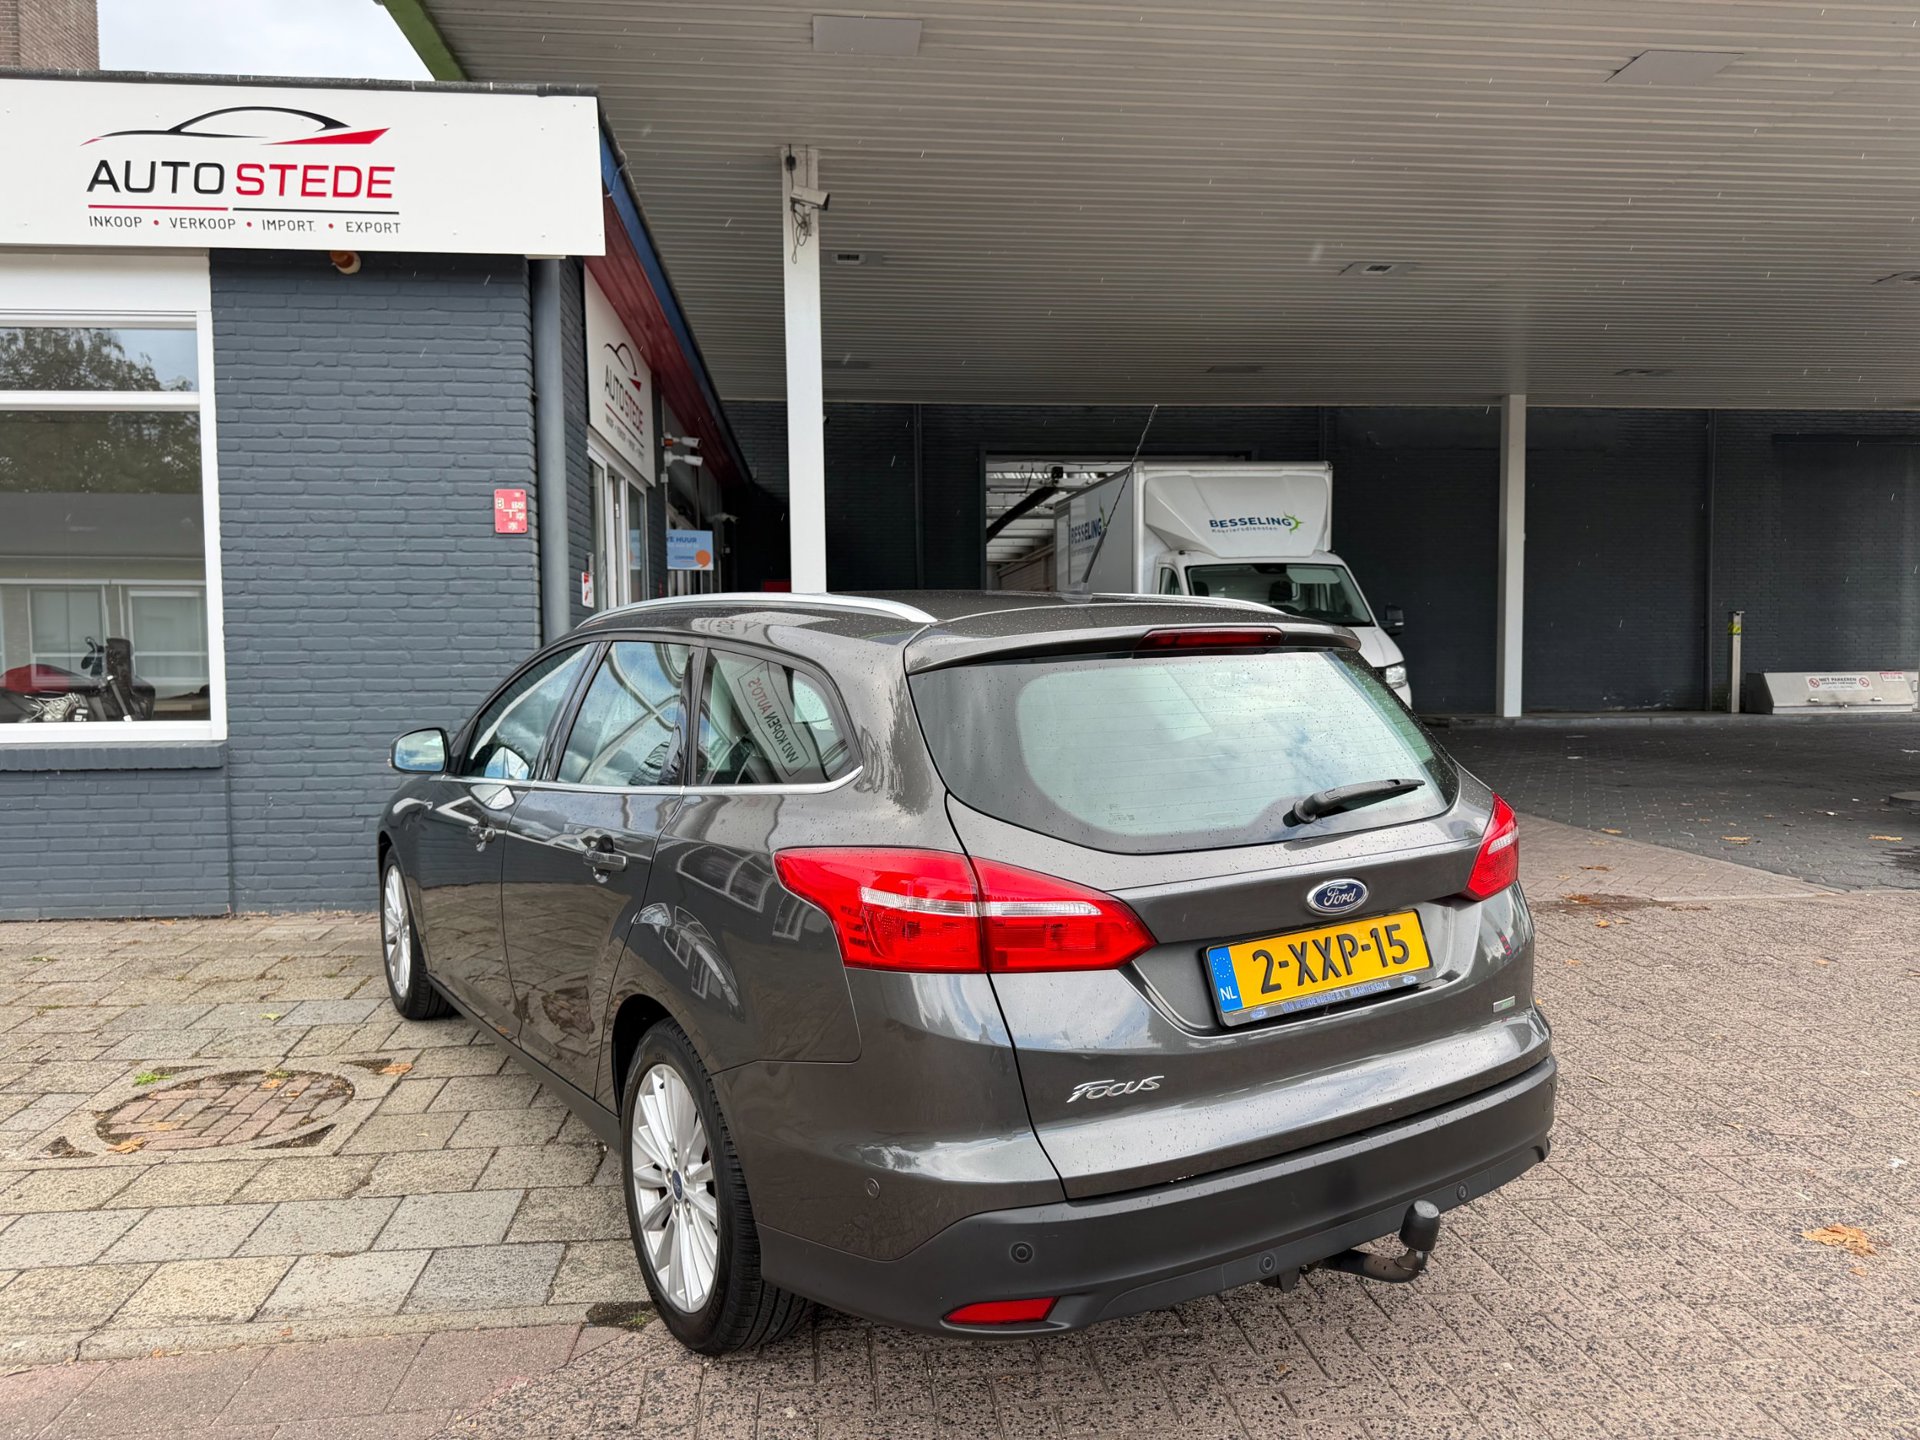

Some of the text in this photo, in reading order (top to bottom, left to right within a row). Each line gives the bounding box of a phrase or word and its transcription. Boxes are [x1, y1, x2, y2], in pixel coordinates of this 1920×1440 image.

[88, 215, 401, 234] INKOOP VERKOOP IMPORT EXPORT
[1070, 517, 1103, 545] BESSELING
[1208, 516, 1292, 529] BESSELING
[1324, 883, 1357, 906] Ford
[1251, 922, 1411, 995] 2-XXP-15
[1219, 985, 1238, 1002] NL
